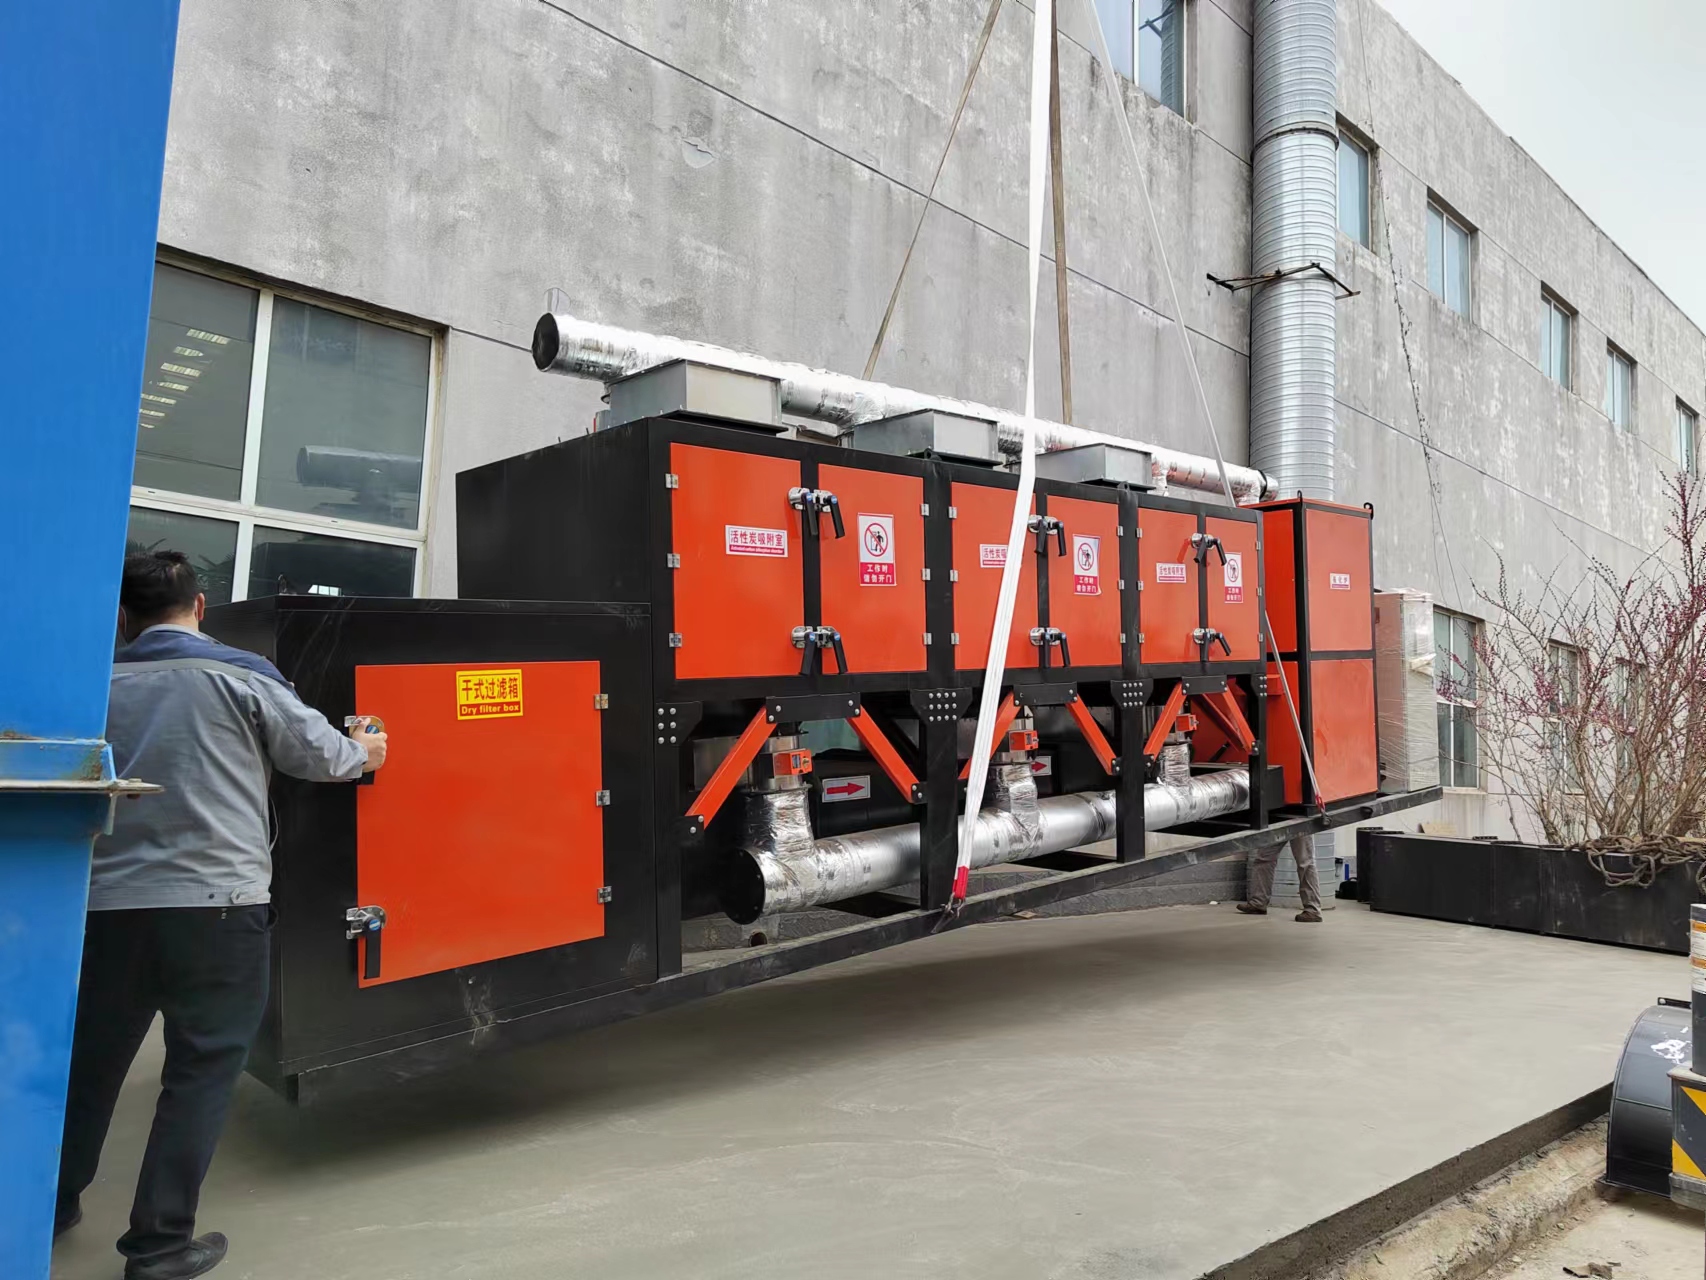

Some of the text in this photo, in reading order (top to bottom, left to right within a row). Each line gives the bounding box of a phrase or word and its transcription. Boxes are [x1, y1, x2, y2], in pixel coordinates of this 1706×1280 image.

[730, 530, 783, 547] 活性炭吸附室
[866, 564, 888, 573] 工作时
[461, 677, 519, 701] 干式过滤箱
[461, 704, 519, 715] Dry filter box
